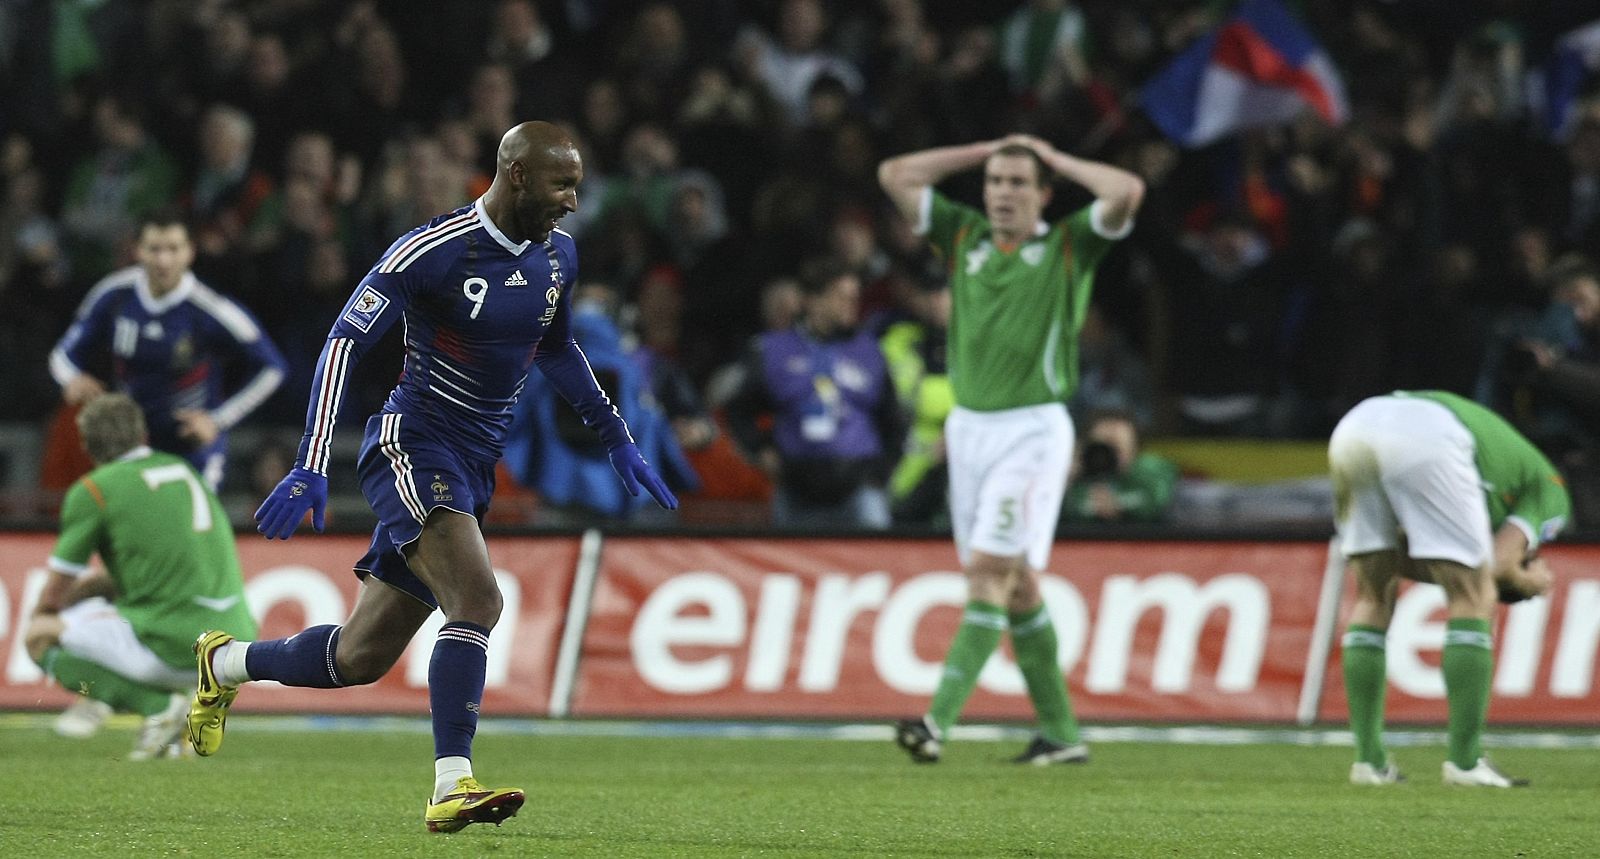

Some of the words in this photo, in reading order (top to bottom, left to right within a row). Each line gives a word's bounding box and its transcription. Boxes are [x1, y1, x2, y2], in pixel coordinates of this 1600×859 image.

[463, 277, 489, 319] 9
[142, 464, 212, 532] 7
[999, 497, 1015, 530] 5
[630, 570, 1271, 694] eircom
